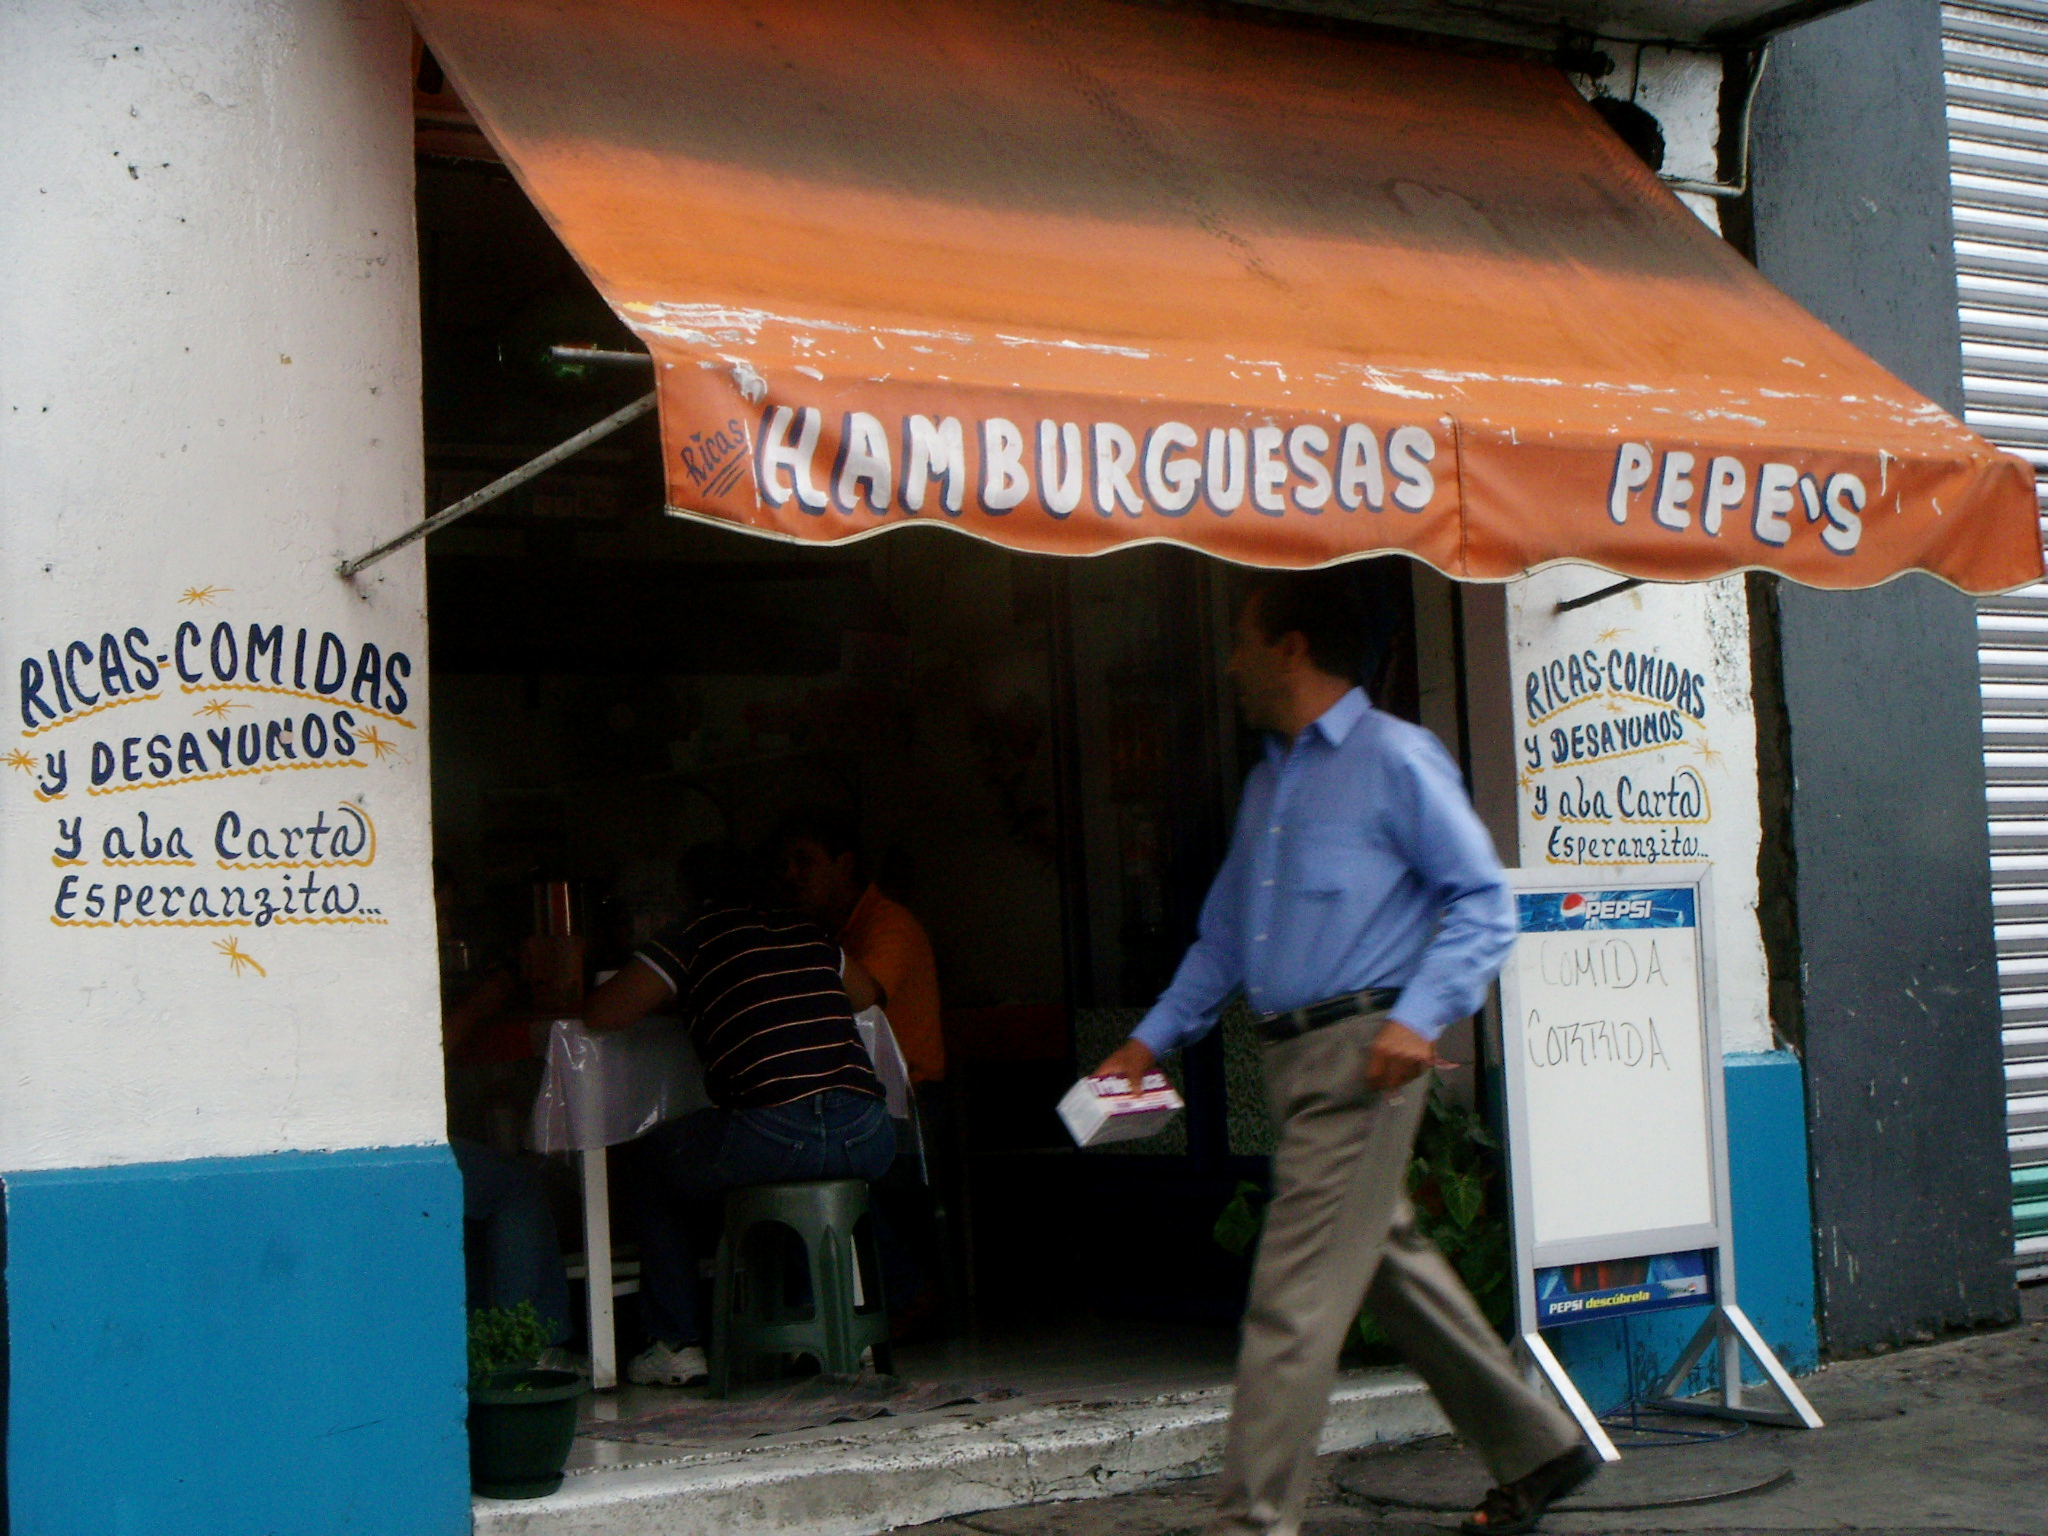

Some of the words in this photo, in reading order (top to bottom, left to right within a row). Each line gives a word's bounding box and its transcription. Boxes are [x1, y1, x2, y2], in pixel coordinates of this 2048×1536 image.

[680, 418, 749, 486] Ricas
[757, 404, 1436, 519] HAMBURGUESAS
[1607, 441, 1867, 556] PEPE'S
[90, 711, 357, 786] DESAYUNOS
[1550, 709, 1684, 764] DESAYUNOS
[1617, 771, 1702, 819] Carta
[214, 806, 367, 860] Carta
[1584, 900, 1653, 921] PEPSI
[1540, 938, 1669, 990] COMIDA
[1527, 1008, 1671, 1072] CORRIDA
[1549, 1299, 1584, 1315] PEPSI
[1585, 1290, 1650, 1309] descúbrela
